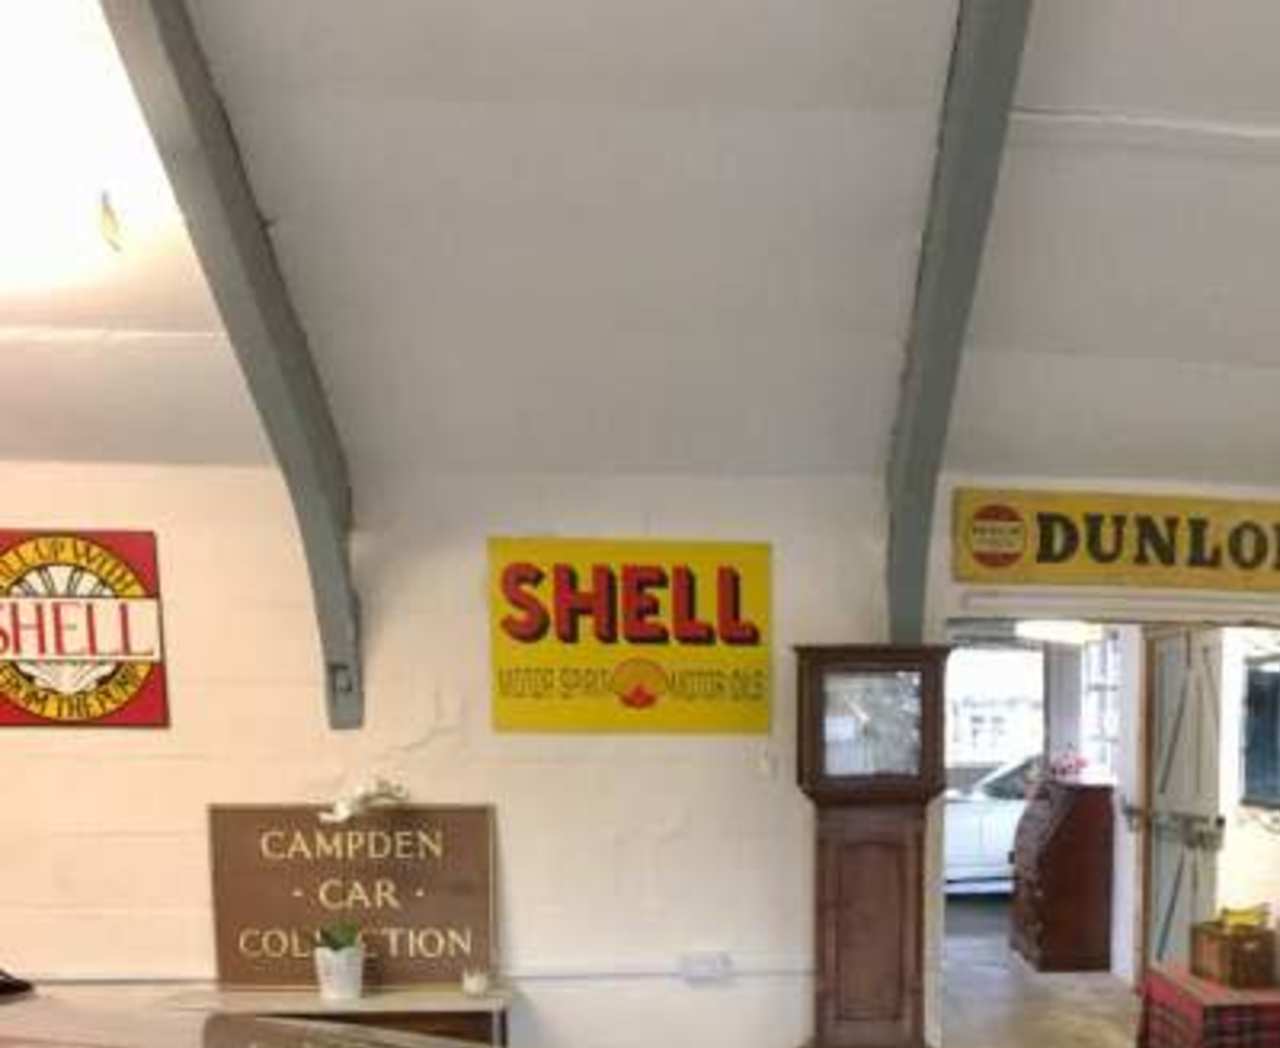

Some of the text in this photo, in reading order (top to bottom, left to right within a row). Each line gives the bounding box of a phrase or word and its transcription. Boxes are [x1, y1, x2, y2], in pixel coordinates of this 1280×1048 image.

[499, 562, 762, 647] SHELL
[260, 831, 443, 860] CAMPDEN
[318, 879, 400, 909] CAR
